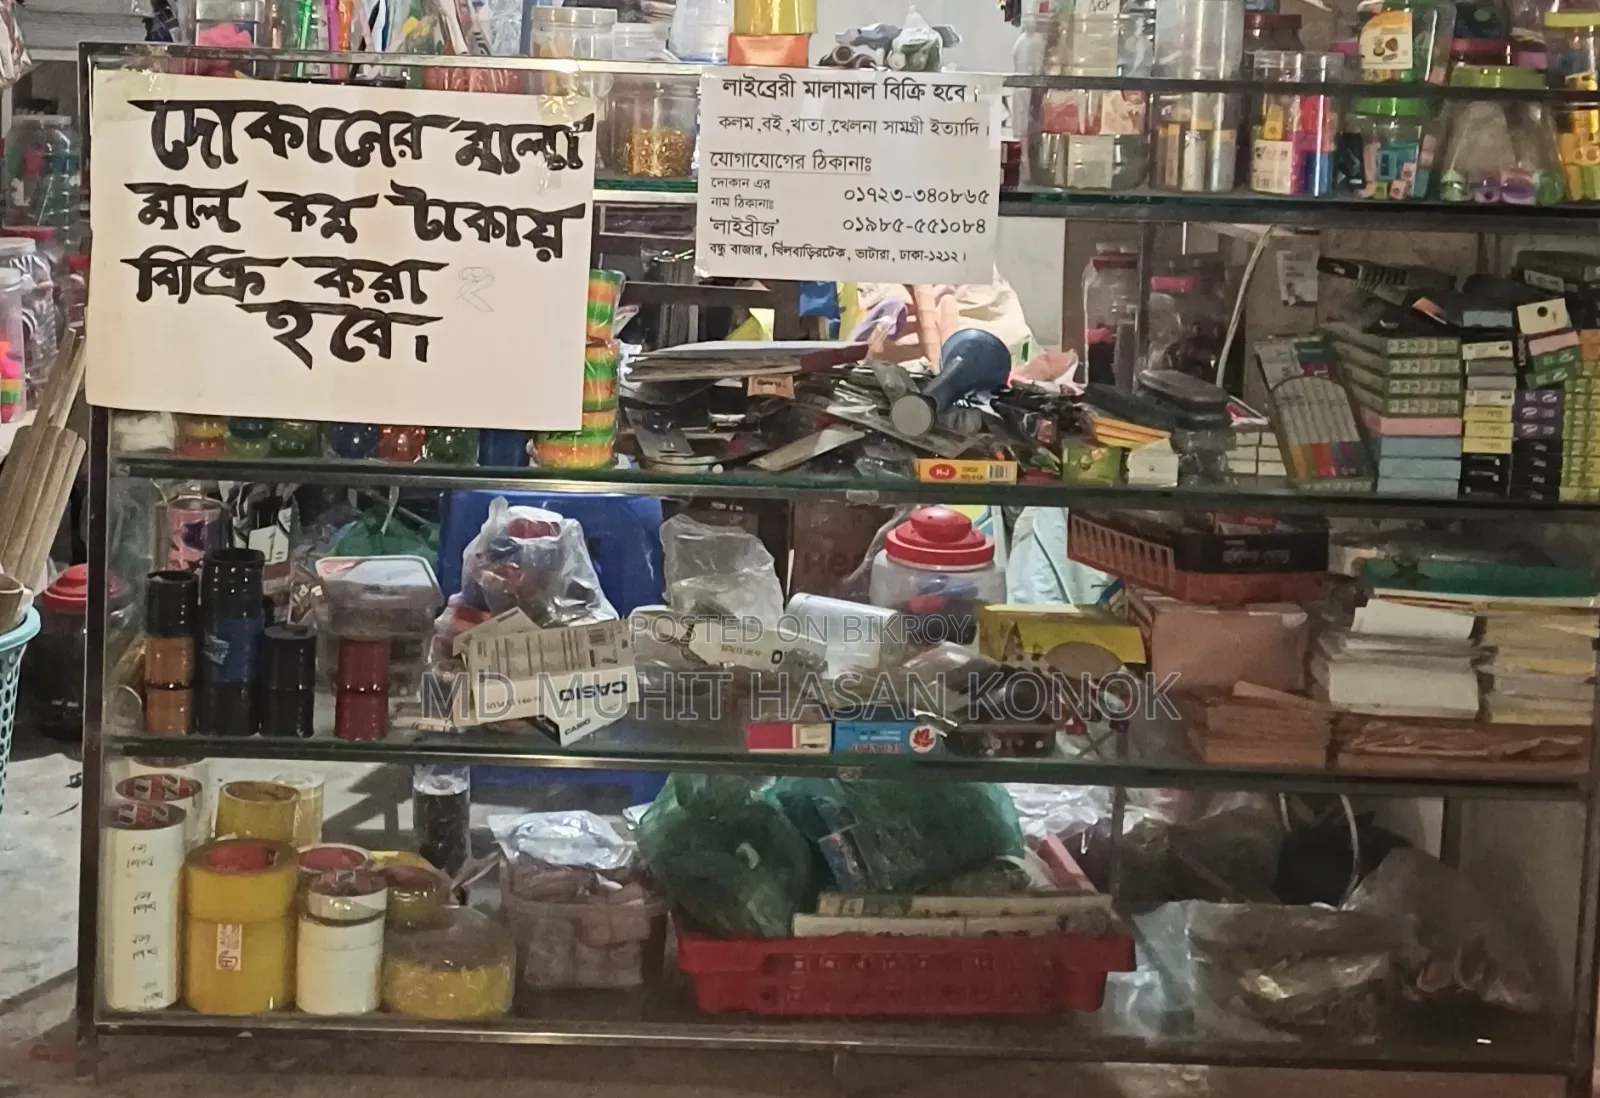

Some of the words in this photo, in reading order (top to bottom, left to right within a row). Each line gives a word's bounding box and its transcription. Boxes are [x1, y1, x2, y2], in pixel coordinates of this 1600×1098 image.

[721, 74, 798, 100] লাইব্রেরী
[802, 81, 877, 100] মালামাল
[883, 77, 927, 101] বিক্রি
[128, 100, 460, 170] দোকানের
[710, 151, 806, 169] যোগাযোগের
[710, 177, 750, 188] দোকান
[754, 179, 771, 189] এর
[710, 197, 730, 208] নাম
[844, 187, 990, 204] ০১৭২৩-৩৪০৮৬৫
[124, 179, 248, 232] মাল
[259, 189, 379, 243] কম
[386, 179, 586, 263] টাকায়
[843, 217, 986, 234] ০১৯৮৫-৫৫১০৮৪
[121, 245, 288, 304] বিক্রি
[293, 255, 449, 305] করা
[558, 680, 628, 703] CASIO
